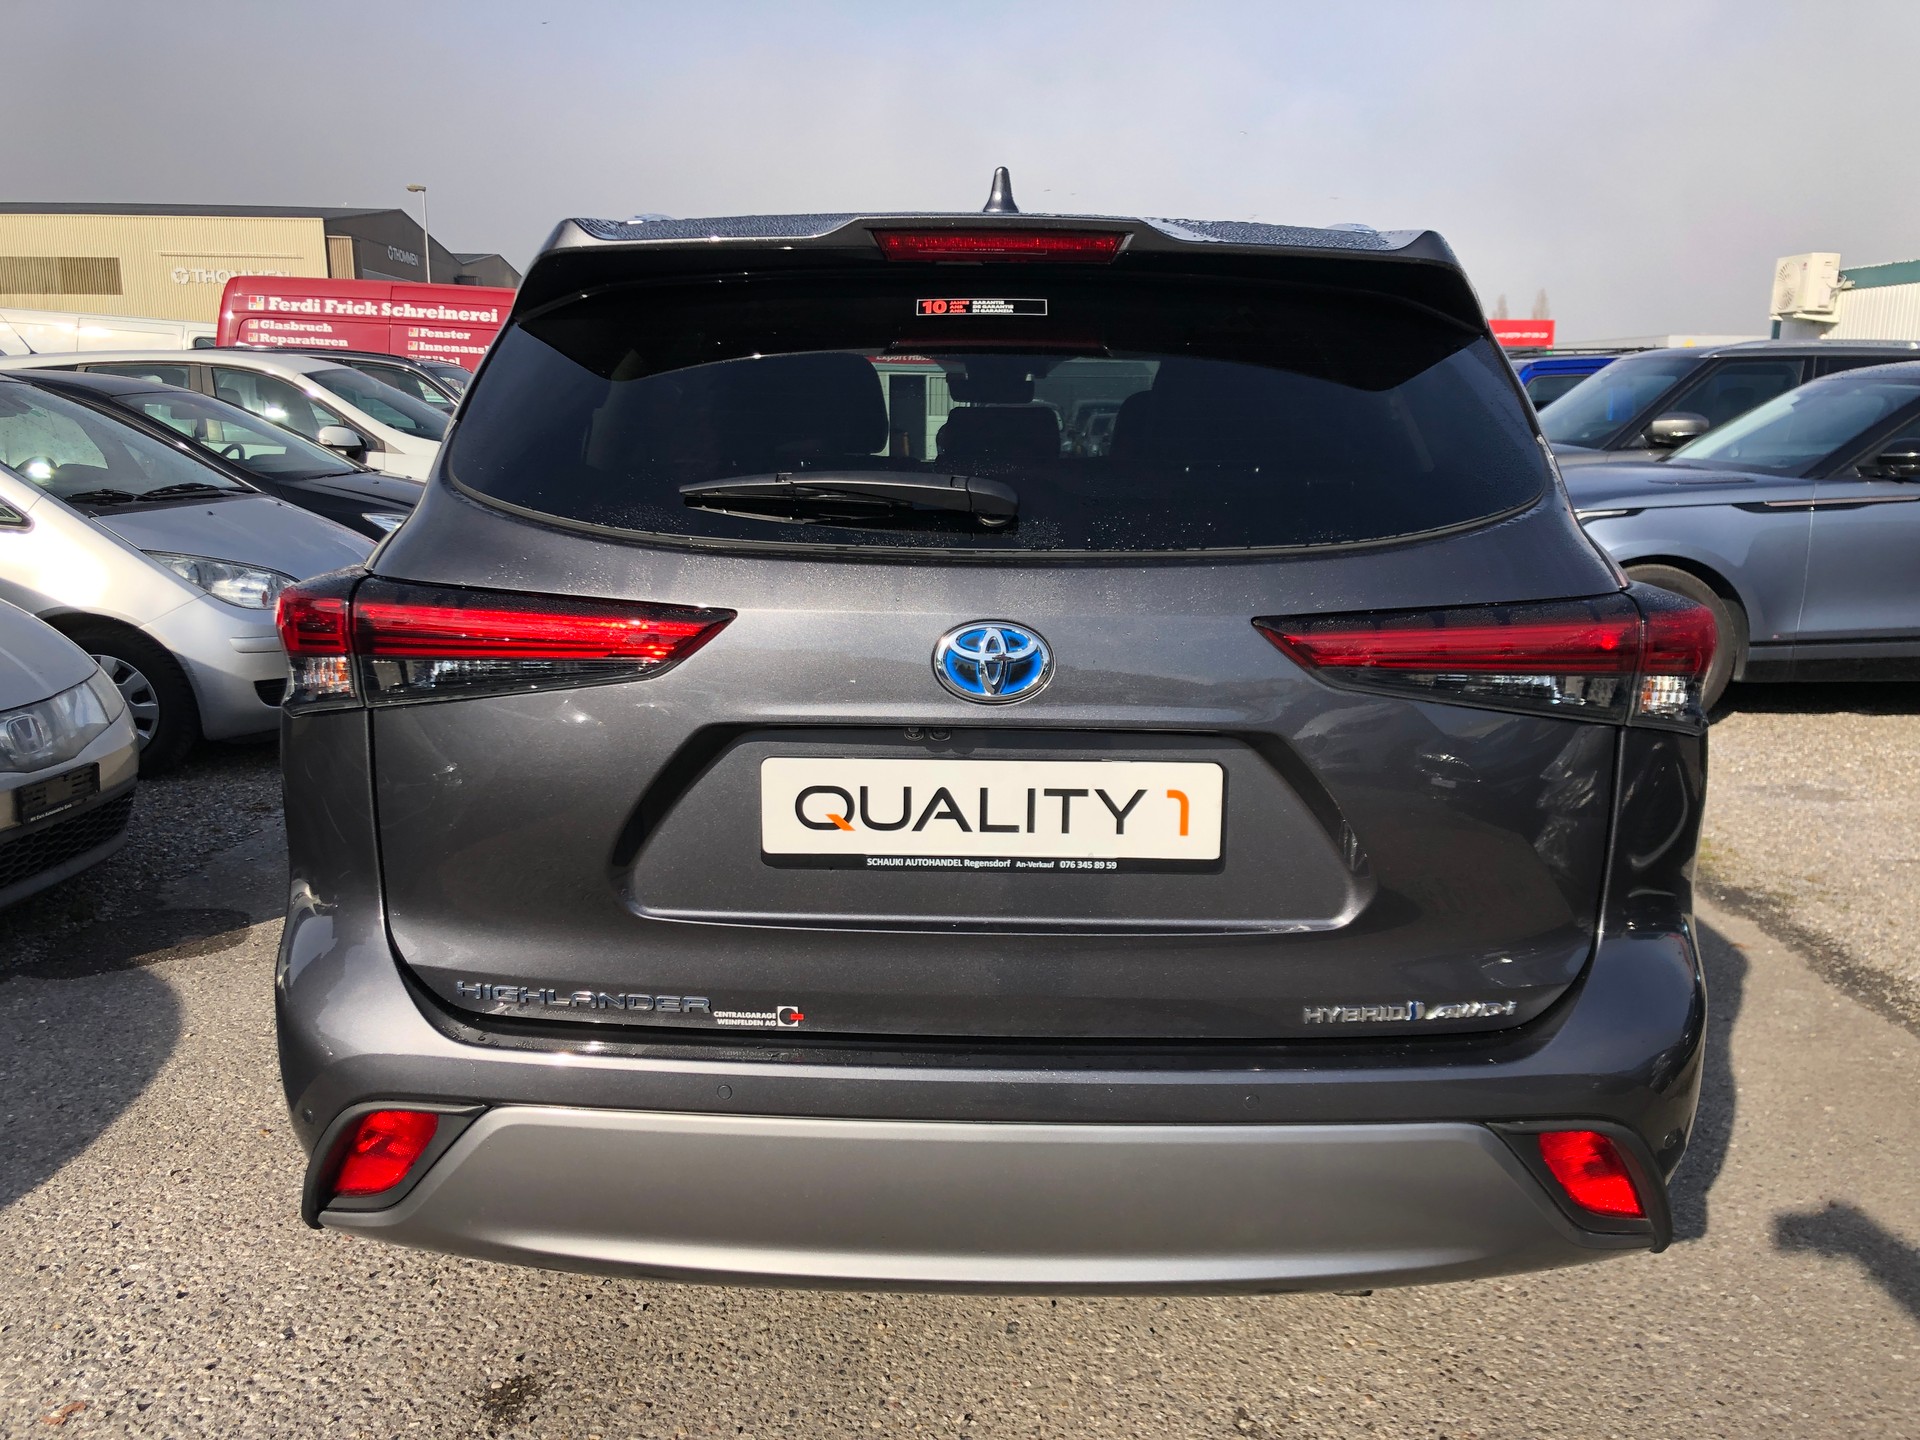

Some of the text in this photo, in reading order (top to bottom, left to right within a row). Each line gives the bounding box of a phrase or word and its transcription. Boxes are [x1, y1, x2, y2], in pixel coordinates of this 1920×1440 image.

[268, 296, 499, 323] Ferdi Frick Schreinerei
[922, 300, 947, 314] 10
[260, 319, 333, 333] Glasbruch
[259, 333, 349, 348] Reparaturen
[419, 327, 471, 340] Fenster
[794, 784, 1190, 837] QUALITY 1
[866, 857, 1118, 870] SCHAUKI AUTOHANDEL Regensdorf An-Verkauf 076 345 89 59
[456, 980, 711, 1014] HIGHLANDER
[713, 1010, 777, 1020] CENTRALGARAGE
[1303, 1003, 1407, 1024] HYBRID
[716, 1018, 777, 1027] WEINFELDEN AG
